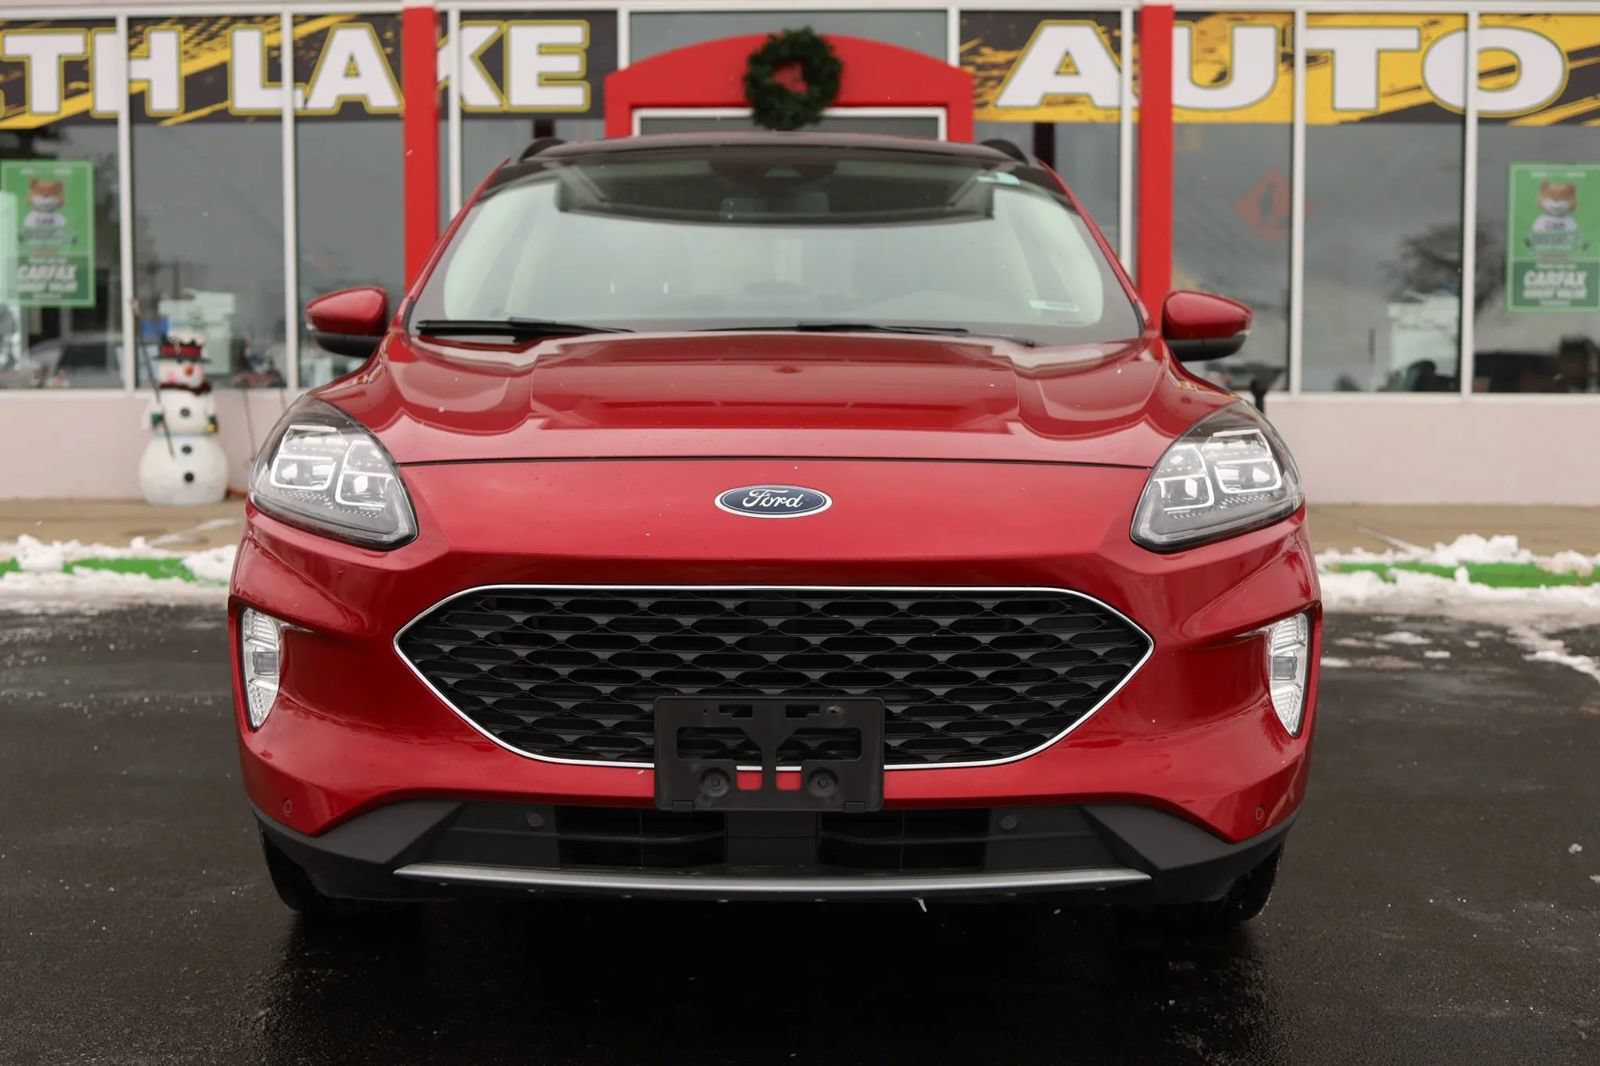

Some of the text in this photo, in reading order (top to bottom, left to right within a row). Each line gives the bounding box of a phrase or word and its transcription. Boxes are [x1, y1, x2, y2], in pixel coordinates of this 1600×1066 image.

[0, 20, 1570, 117] TH LAKE AUTO
[742, 488, 804, 508] Ford
